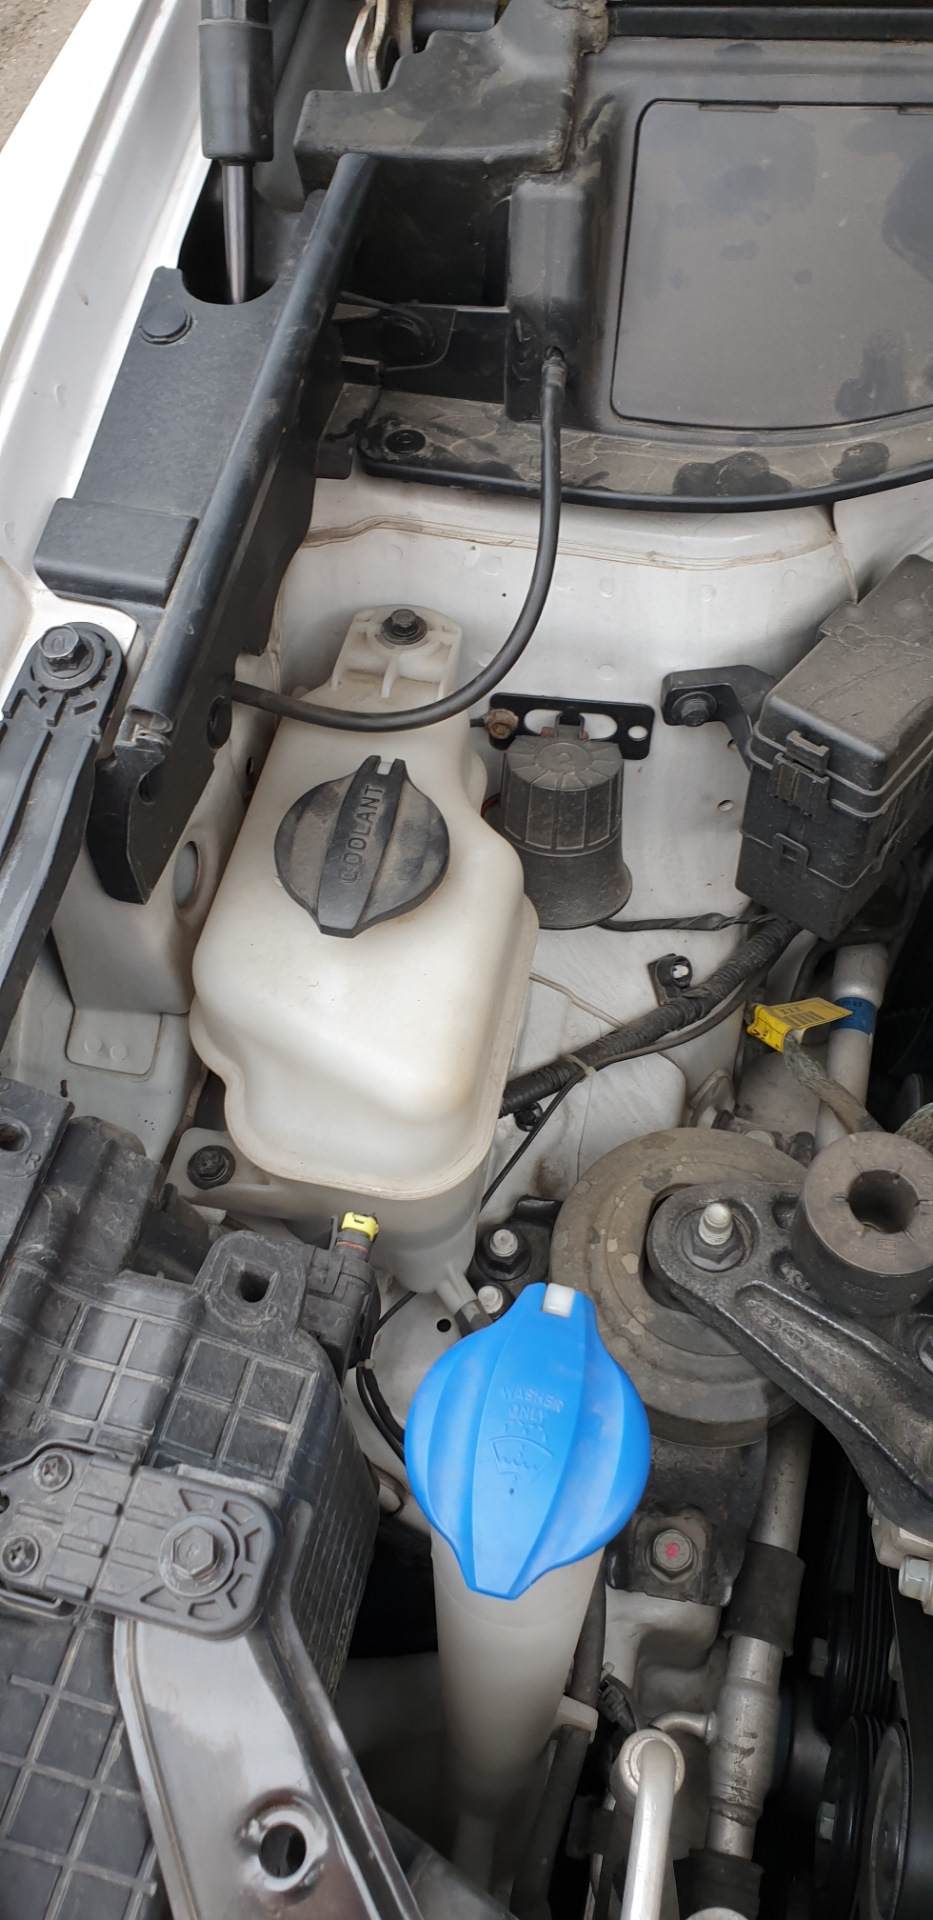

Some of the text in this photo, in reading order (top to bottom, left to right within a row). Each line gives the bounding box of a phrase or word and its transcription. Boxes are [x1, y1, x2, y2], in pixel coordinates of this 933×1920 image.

[338, 785, 383, 884] COOLANT
[502, 1387, 564, 1413] WASHER
[510, 1403, 546, 1423] ONLY
